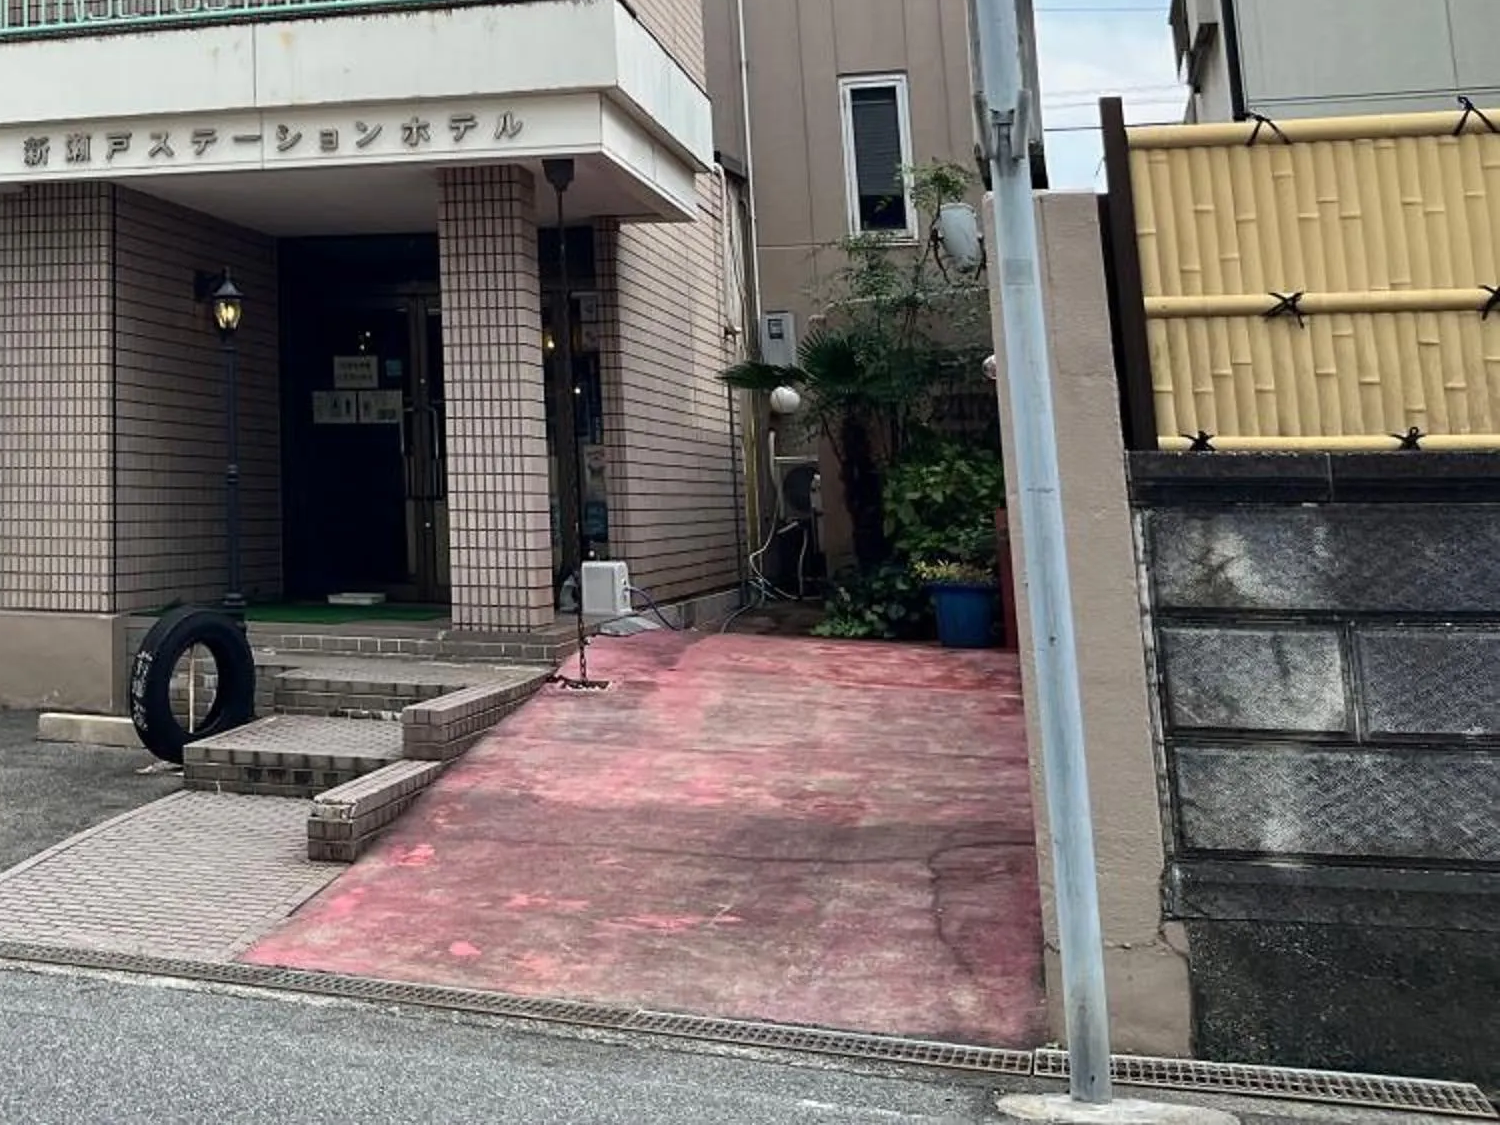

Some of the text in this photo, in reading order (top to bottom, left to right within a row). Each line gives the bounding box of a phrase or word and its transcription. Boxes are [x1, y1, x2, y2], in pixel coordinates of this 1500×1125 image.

[23, 110, 523, 167] 新瀬戸ステーションホテル
